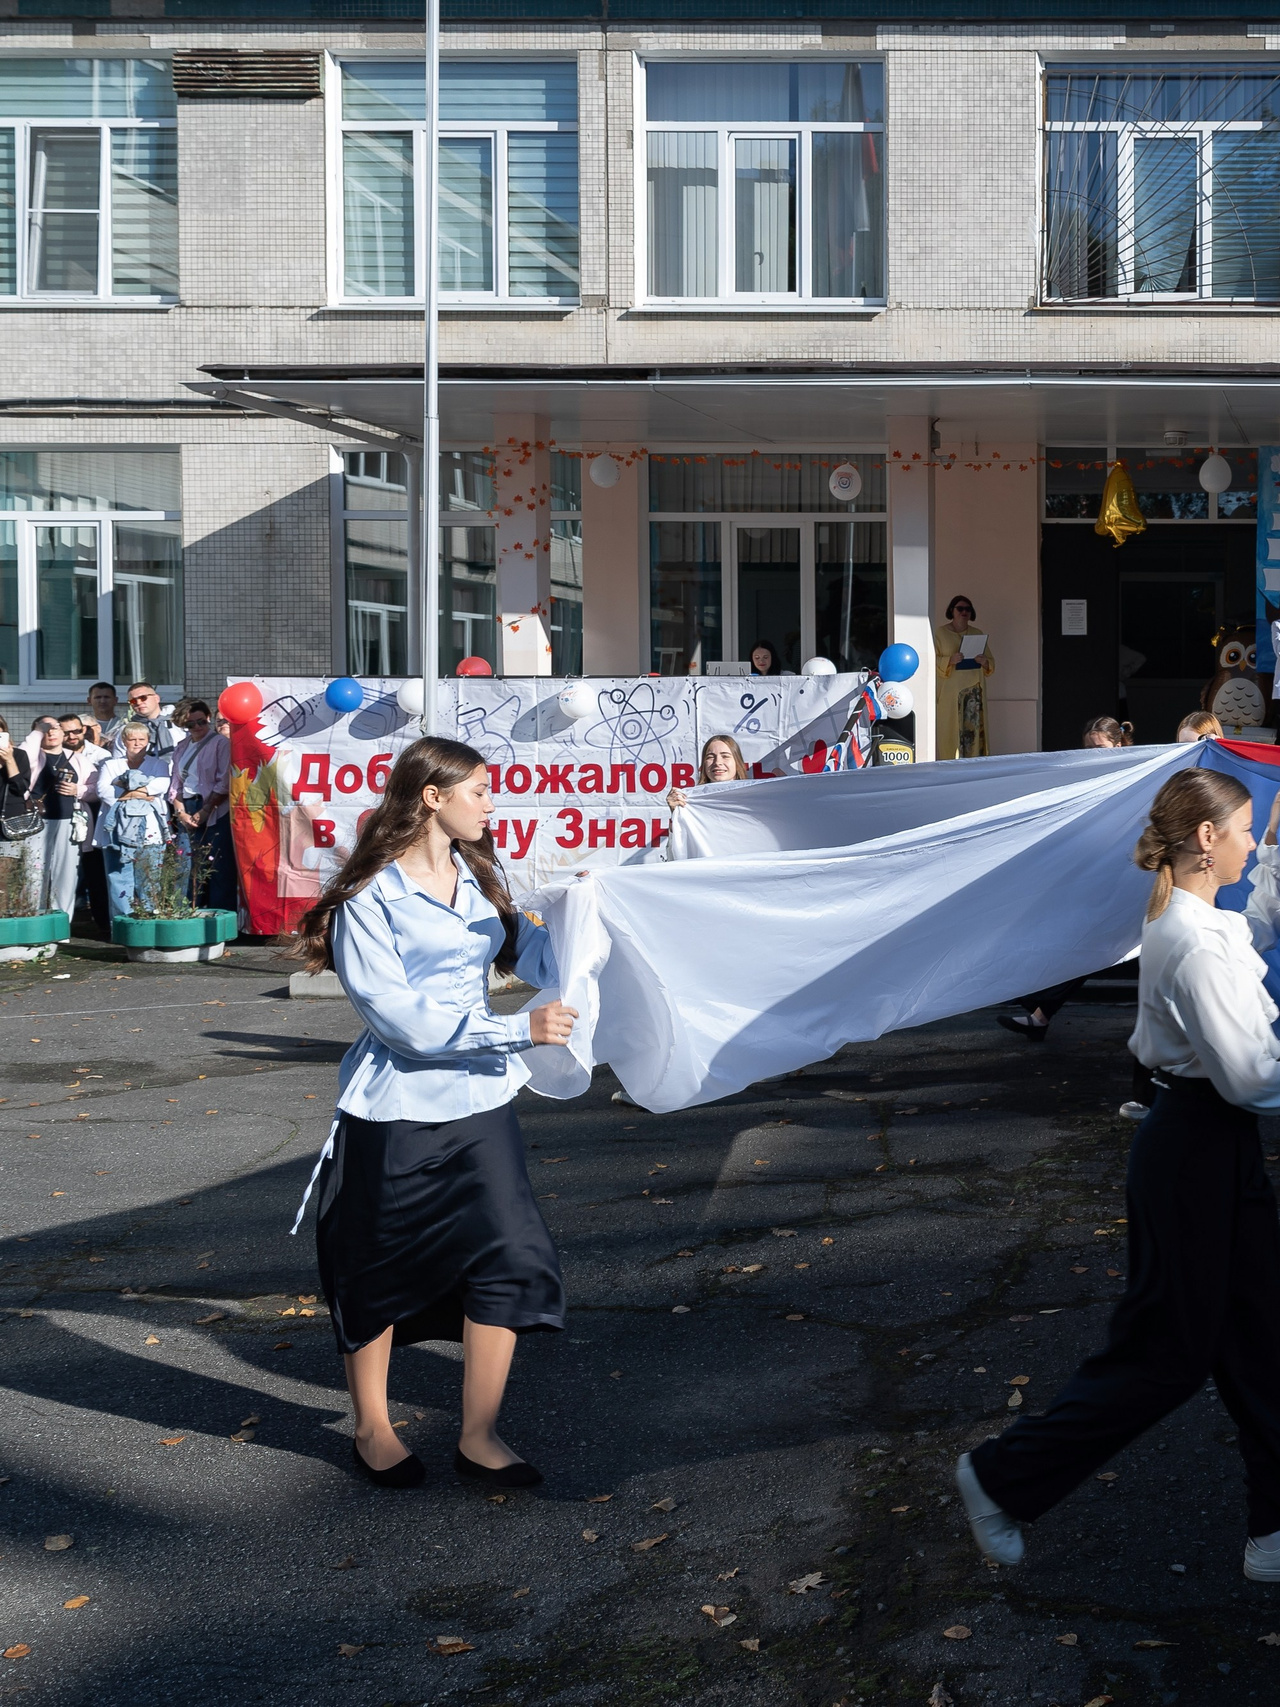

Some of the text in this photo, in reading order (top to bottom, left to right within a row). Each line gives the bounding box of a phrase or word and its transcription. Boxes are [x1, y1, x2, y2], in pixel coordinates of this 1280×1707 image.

[292, 752, 393, 802] Доб
[883, 751, 910, 761] 1000
[312, 819, 335, 848] в
[555, 807, 670, 849] Знан
